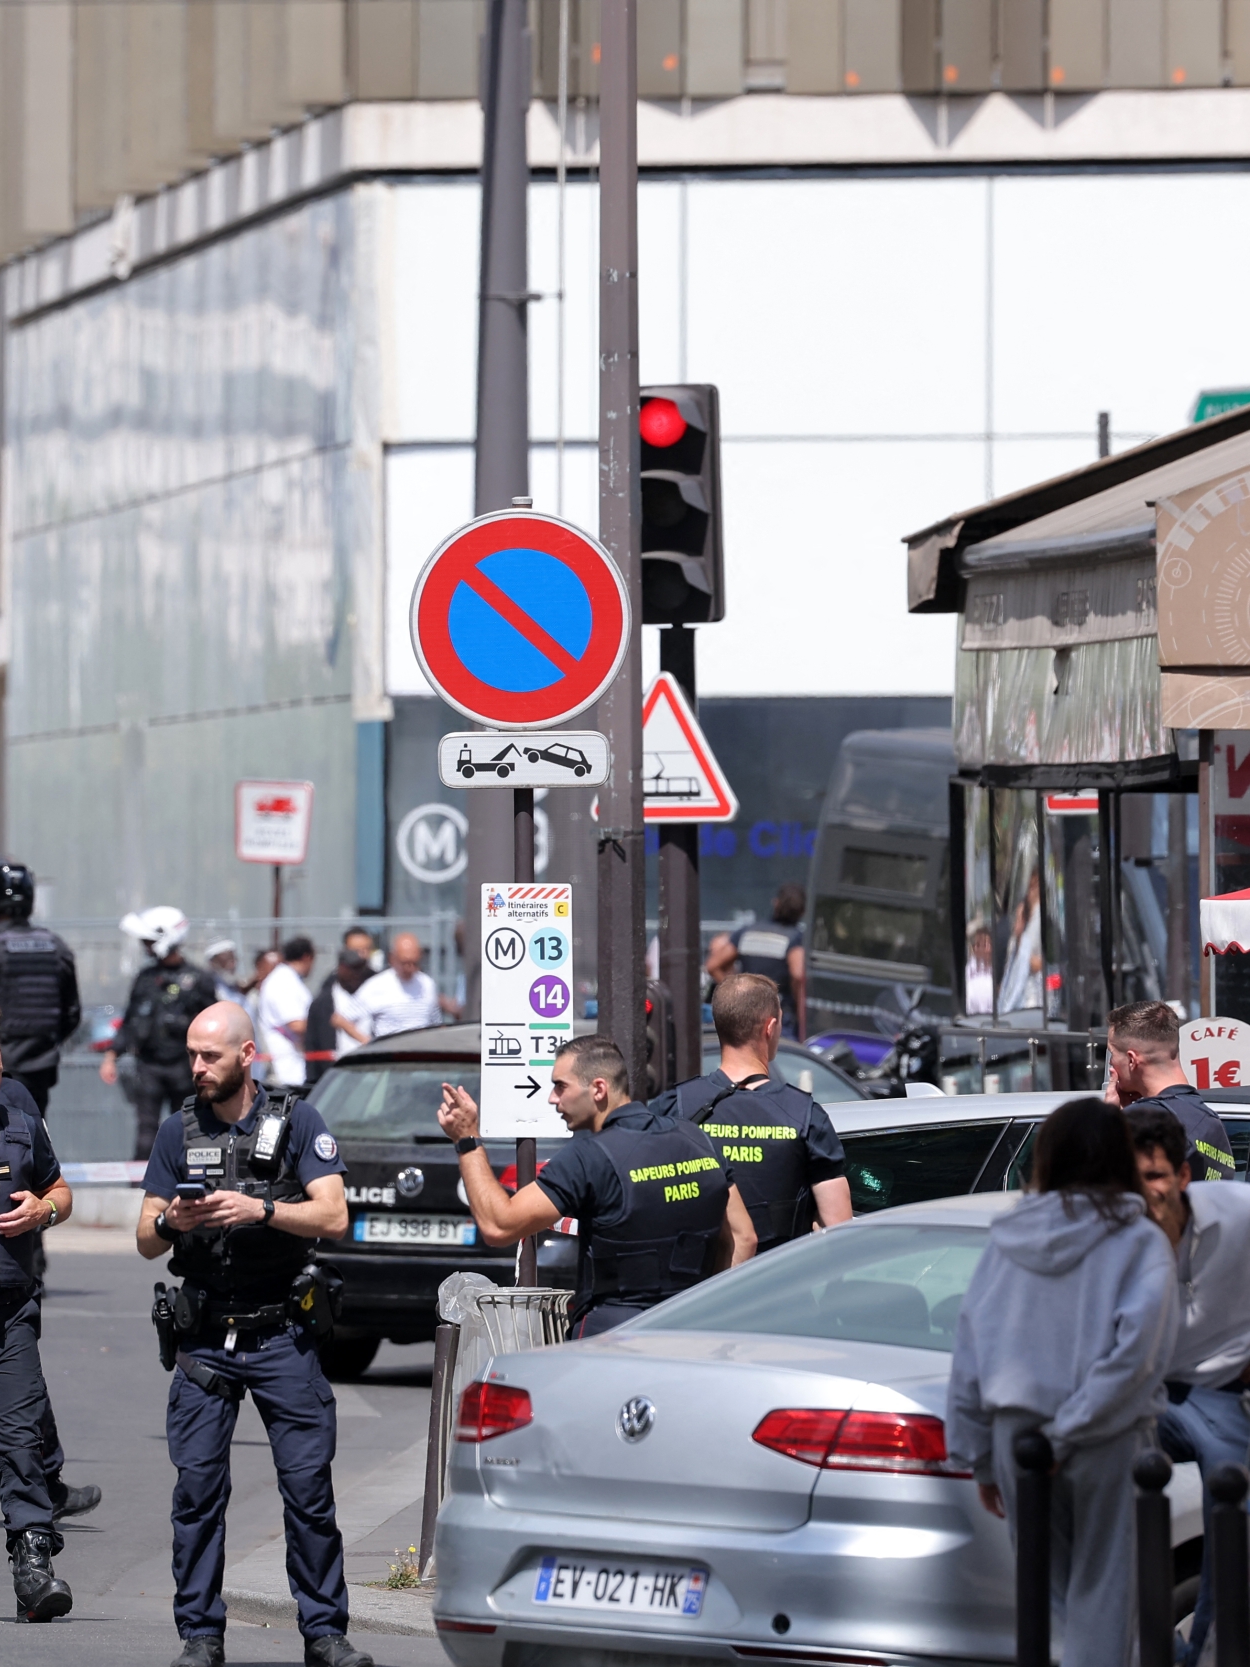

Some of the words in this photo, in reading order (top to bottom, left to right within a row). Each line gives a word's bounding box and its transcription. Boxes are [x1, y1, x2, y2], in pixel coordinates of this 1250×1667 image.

[507, 901, 549, 909] Itinéraires
[507, 909, 549, 918] alternatifs
[557, 905, 564, 915] C
[494, 937, 516, 961] M
[533, 936, 563, 961] 13
[533, 984, 565, 1009] 14
[1190, 1026, 1239, 1042] CAFÉ
[1190, 1057, 1241, 1090] 1€
[741, 1125, 797, 1140] POMPIERS
[722, 1145, 763, 1162] PARIS
[629, 1164, 676, 1183] SAPEURS
[677, 1157, 720, 1176] POMPIERS
[664, 1181, 700, 1203] PARIS
